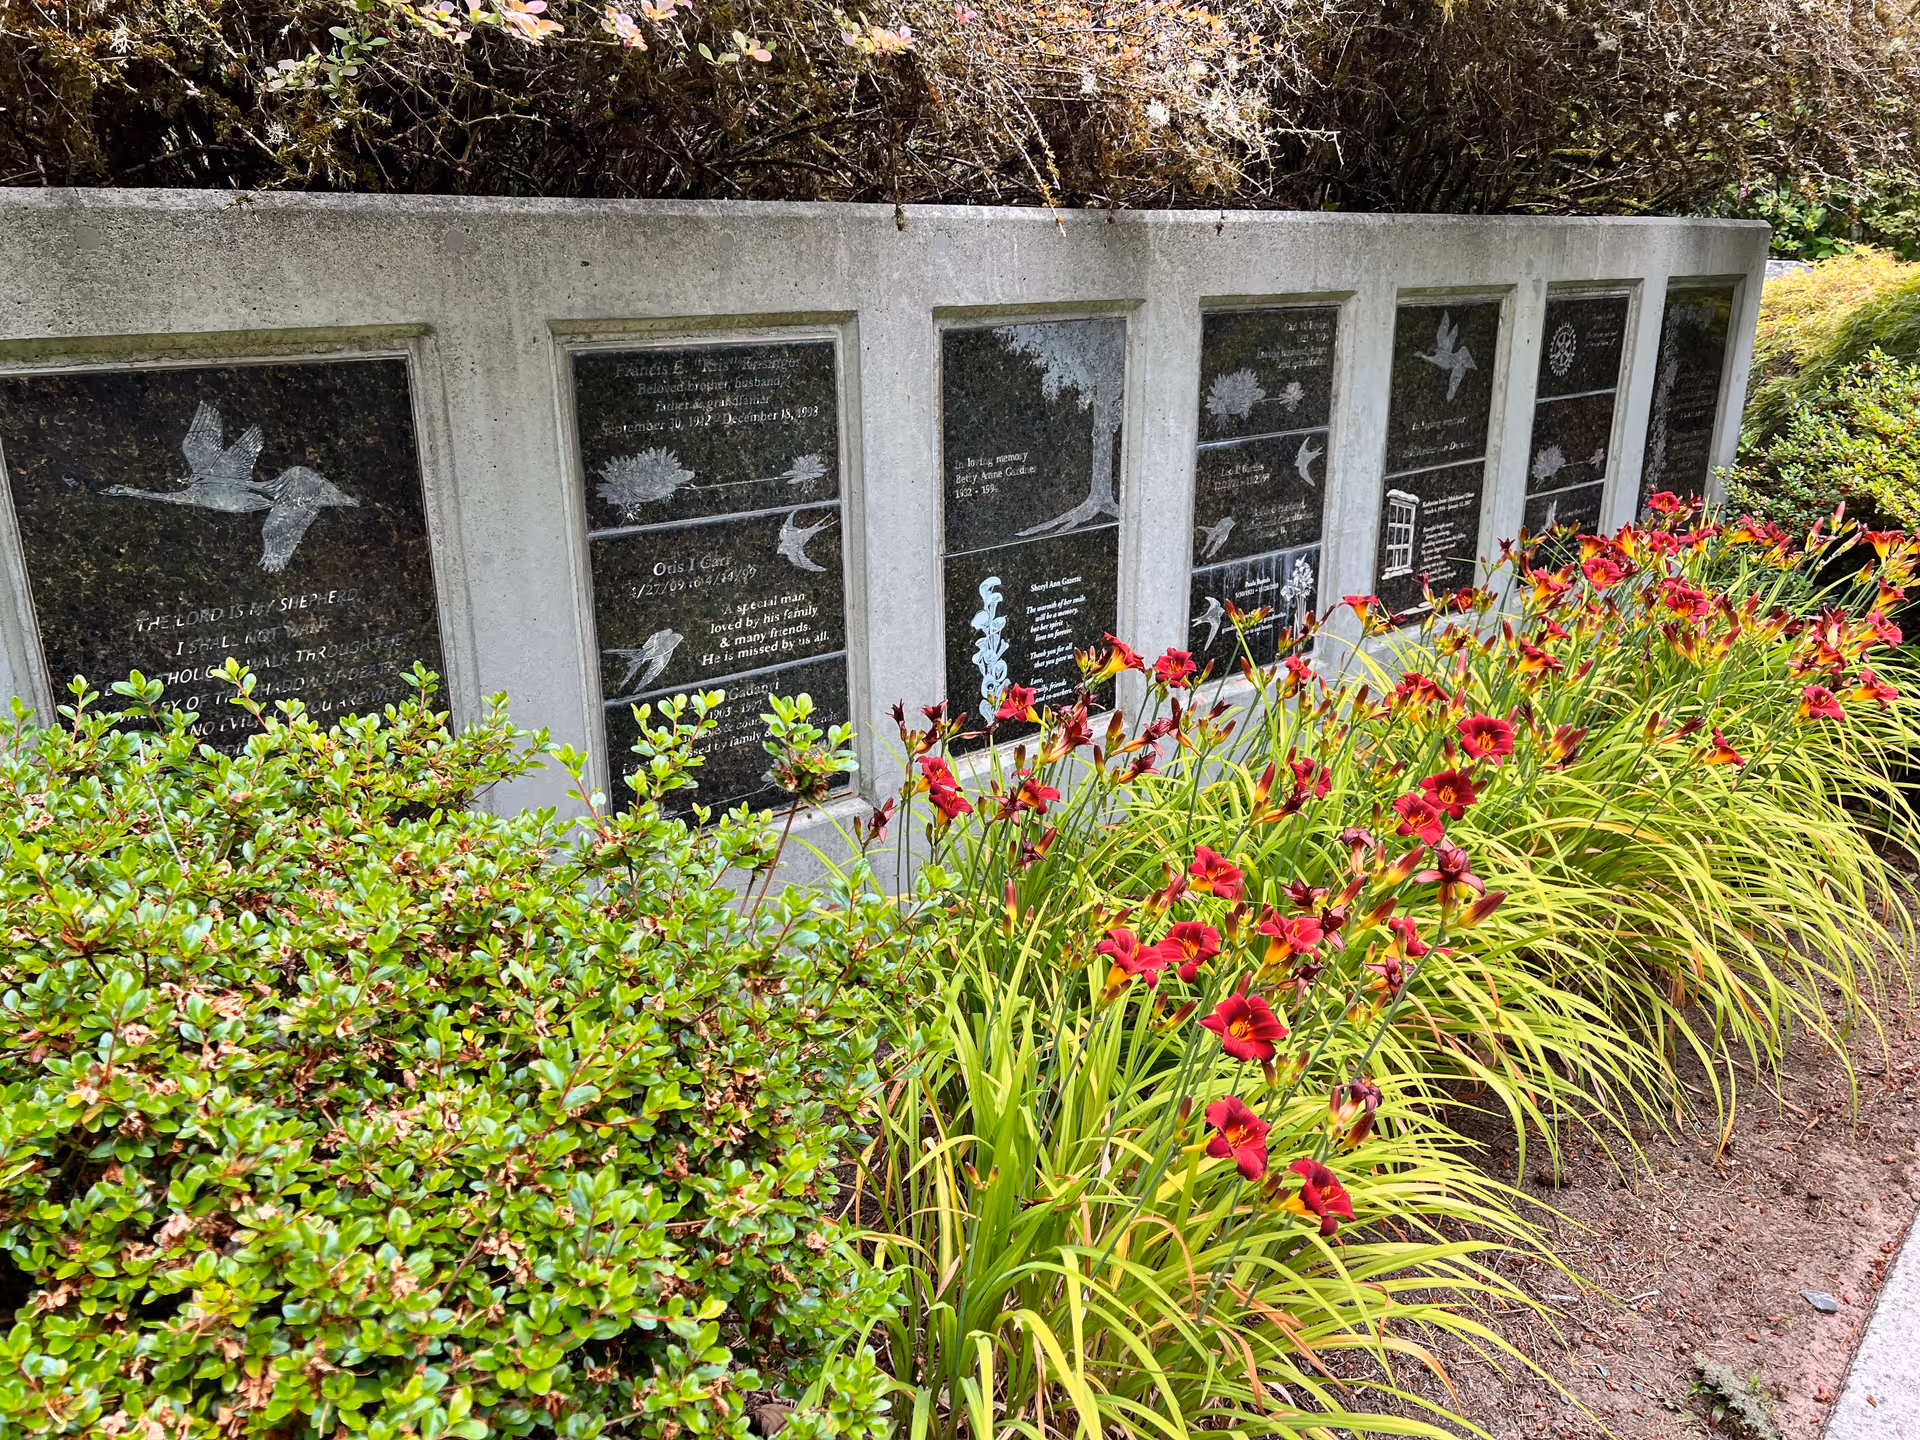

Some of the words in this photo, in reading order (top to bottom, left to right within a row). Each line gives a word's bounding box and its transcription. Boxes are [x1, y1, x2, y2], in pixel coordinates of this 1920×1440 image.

[637, 380, 683, 395] Beloved
[687, 379, 731, 392] brother,
[735, 375, 783, 389] husband,
[601, 419, 666, 438] September
[721, 411, 778, 425] December
[967, 457, 993, 467] loving
[996, 451, 1028, 463] memory
[956, 473, 977, 484] Betty
[981, 470, 1003, 480] Anne
[652, 558, 684, 577] Otis
[700, 555, 732, 569] Carr
[1030, 581, 1049, 592] Sheryl
[1049, 580, 1061, 588] Ann
[136, 614, 170, 632] THE
[176, 608, 224, 627] LORD
[229, 603, 245, 619] IS
[250, 599, 276, 616] MY
[279, 588, 359, 612] SHEPHERD
[723, 604, 734, 615] A
[736, 593, 778, 615] special
[780, 592, 805, 605] man
[1026, 605, 1036, 614] The
[1037, 600, 1057, 611] warmth
[1072, 594, 1086, 603] smile
[710, 618, 742, 634] loved
[746, 615, 761, 629] by
[763, 612, 780, 625] his
[783, 605, 819, 622] family
[1030, 625, 1039, 633] but
[1040, 623, 1049, 631] her
[1049, 619, 1063, 630] spirit
[1035, 612, 1046, 622] will
[176, 641, 184, 656] I
[188, 635, 240, 654] SHALL
[245, 626, 282, 644] NOT
[719, 637, 731, 648] &
[734, 632, 767, 646] many
[769, 623, 812, 639] friends.
[1035, 633, 1046, 641] lives
[1053, 628, 1072, 639] forever.
[247, 652, 290, 671] WALK
[296, 638, 370, 663] THROUGH
[702, 653, 721, 666] He
[724, 650, 734, 662] is
[737, 638, 779, 659] missed
[781, 640, 796, 655] by
[798, 636, 811, 648] us
[813, 631, 830, 644] all.
[1030, 649, 1046, 660] Thank
[1046, 648, 1056, 657] you
[1056, 645, 1065, 655] for
[1065, 642, 1073, 650] all
[1034, 660, 1045, 668] that
[1045, 658, 1055, 667] you
[1055, 655, 1067, 665] gave
[186, 695, 207, 711] OF
[250, 675, 320, 699] SHADOW
[1049, 678, 1067, 691] friends
[1035, 693, 1046, 703] and
[709, 705, 732, 720] 1903
[190, 720, 216, 737] NO
[714, 741, 728, 752] by
[729, 731, 761, 747] family
